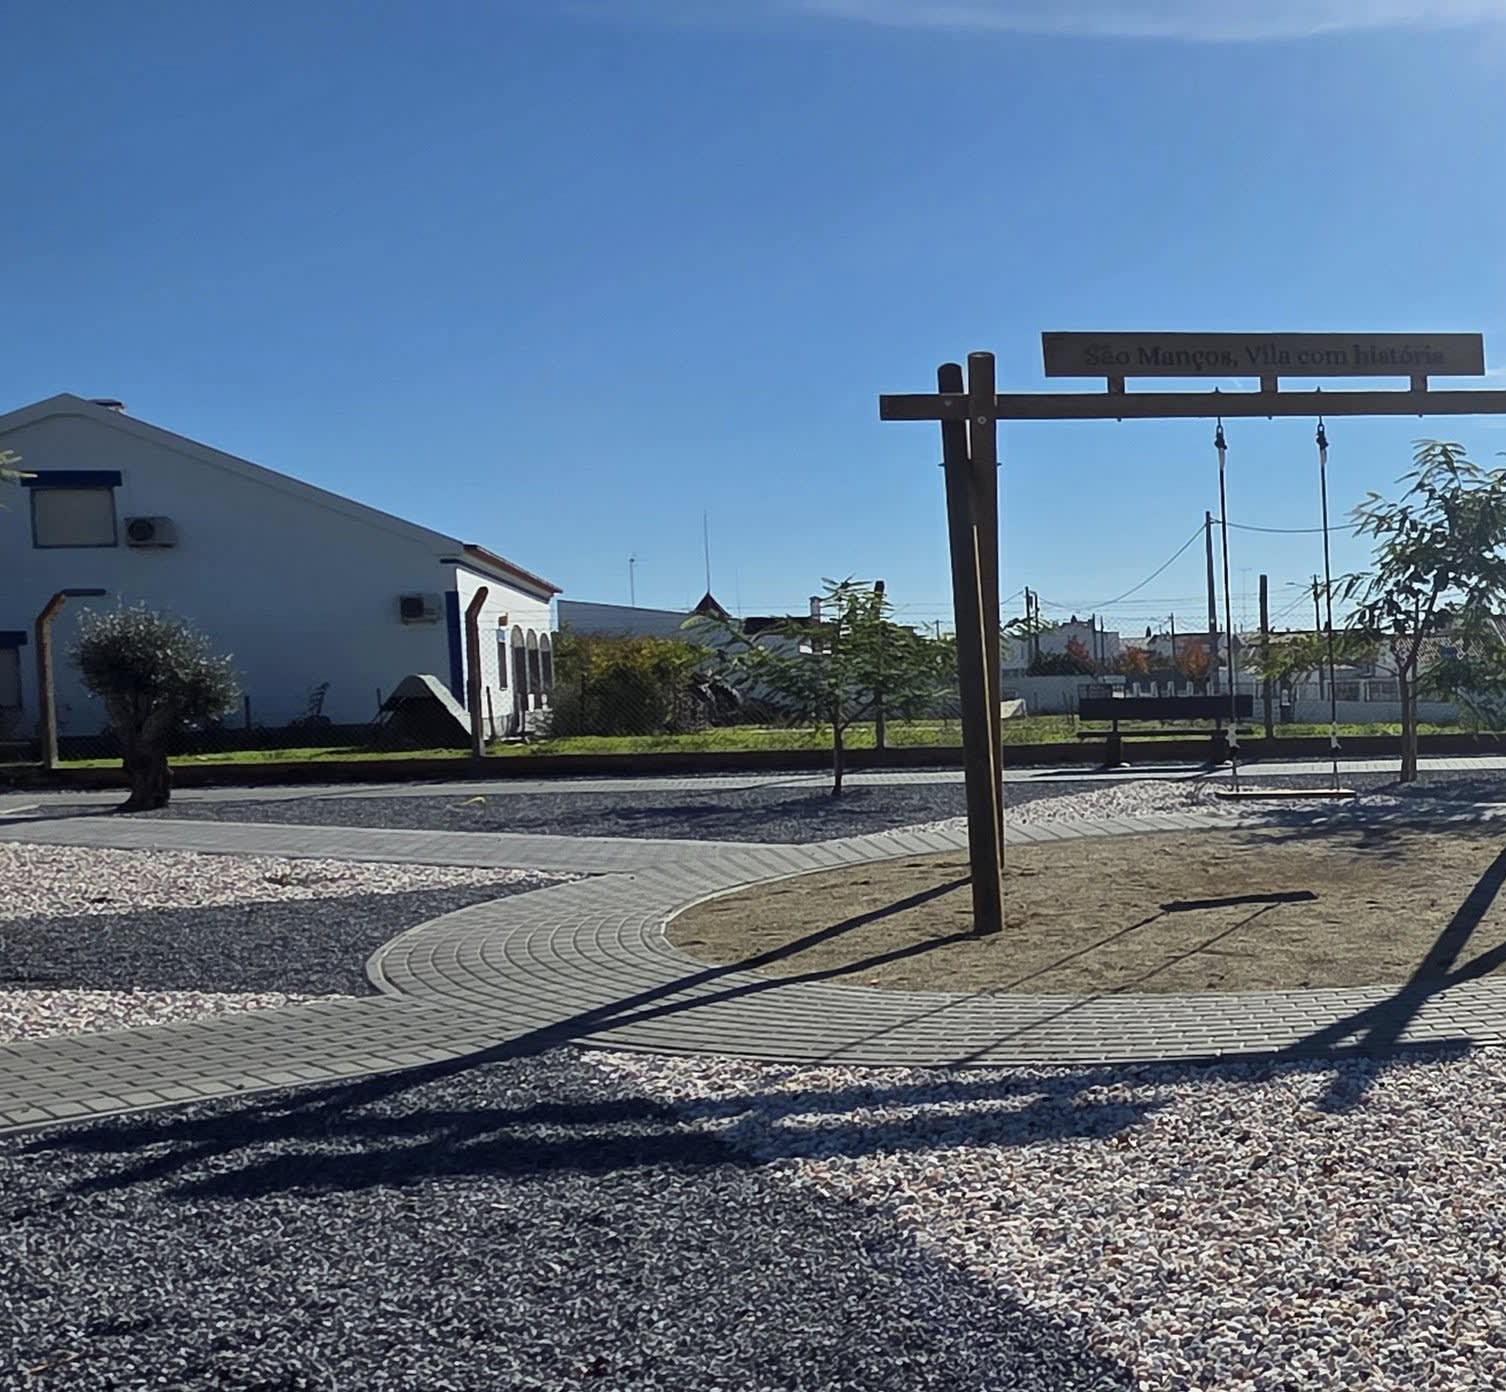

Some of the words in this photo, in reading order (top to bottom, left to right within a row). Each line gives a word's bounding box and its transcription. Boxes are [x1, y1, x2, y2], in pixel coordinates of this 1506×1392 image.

[1085, 343, 1130, 366] São
[1137, 346, 1238, 370] Manços,
[1246, 343, 1291, 365] Vila
[1298, 350, 1348, 365] com
[1353, 344, 1446, 365] história
